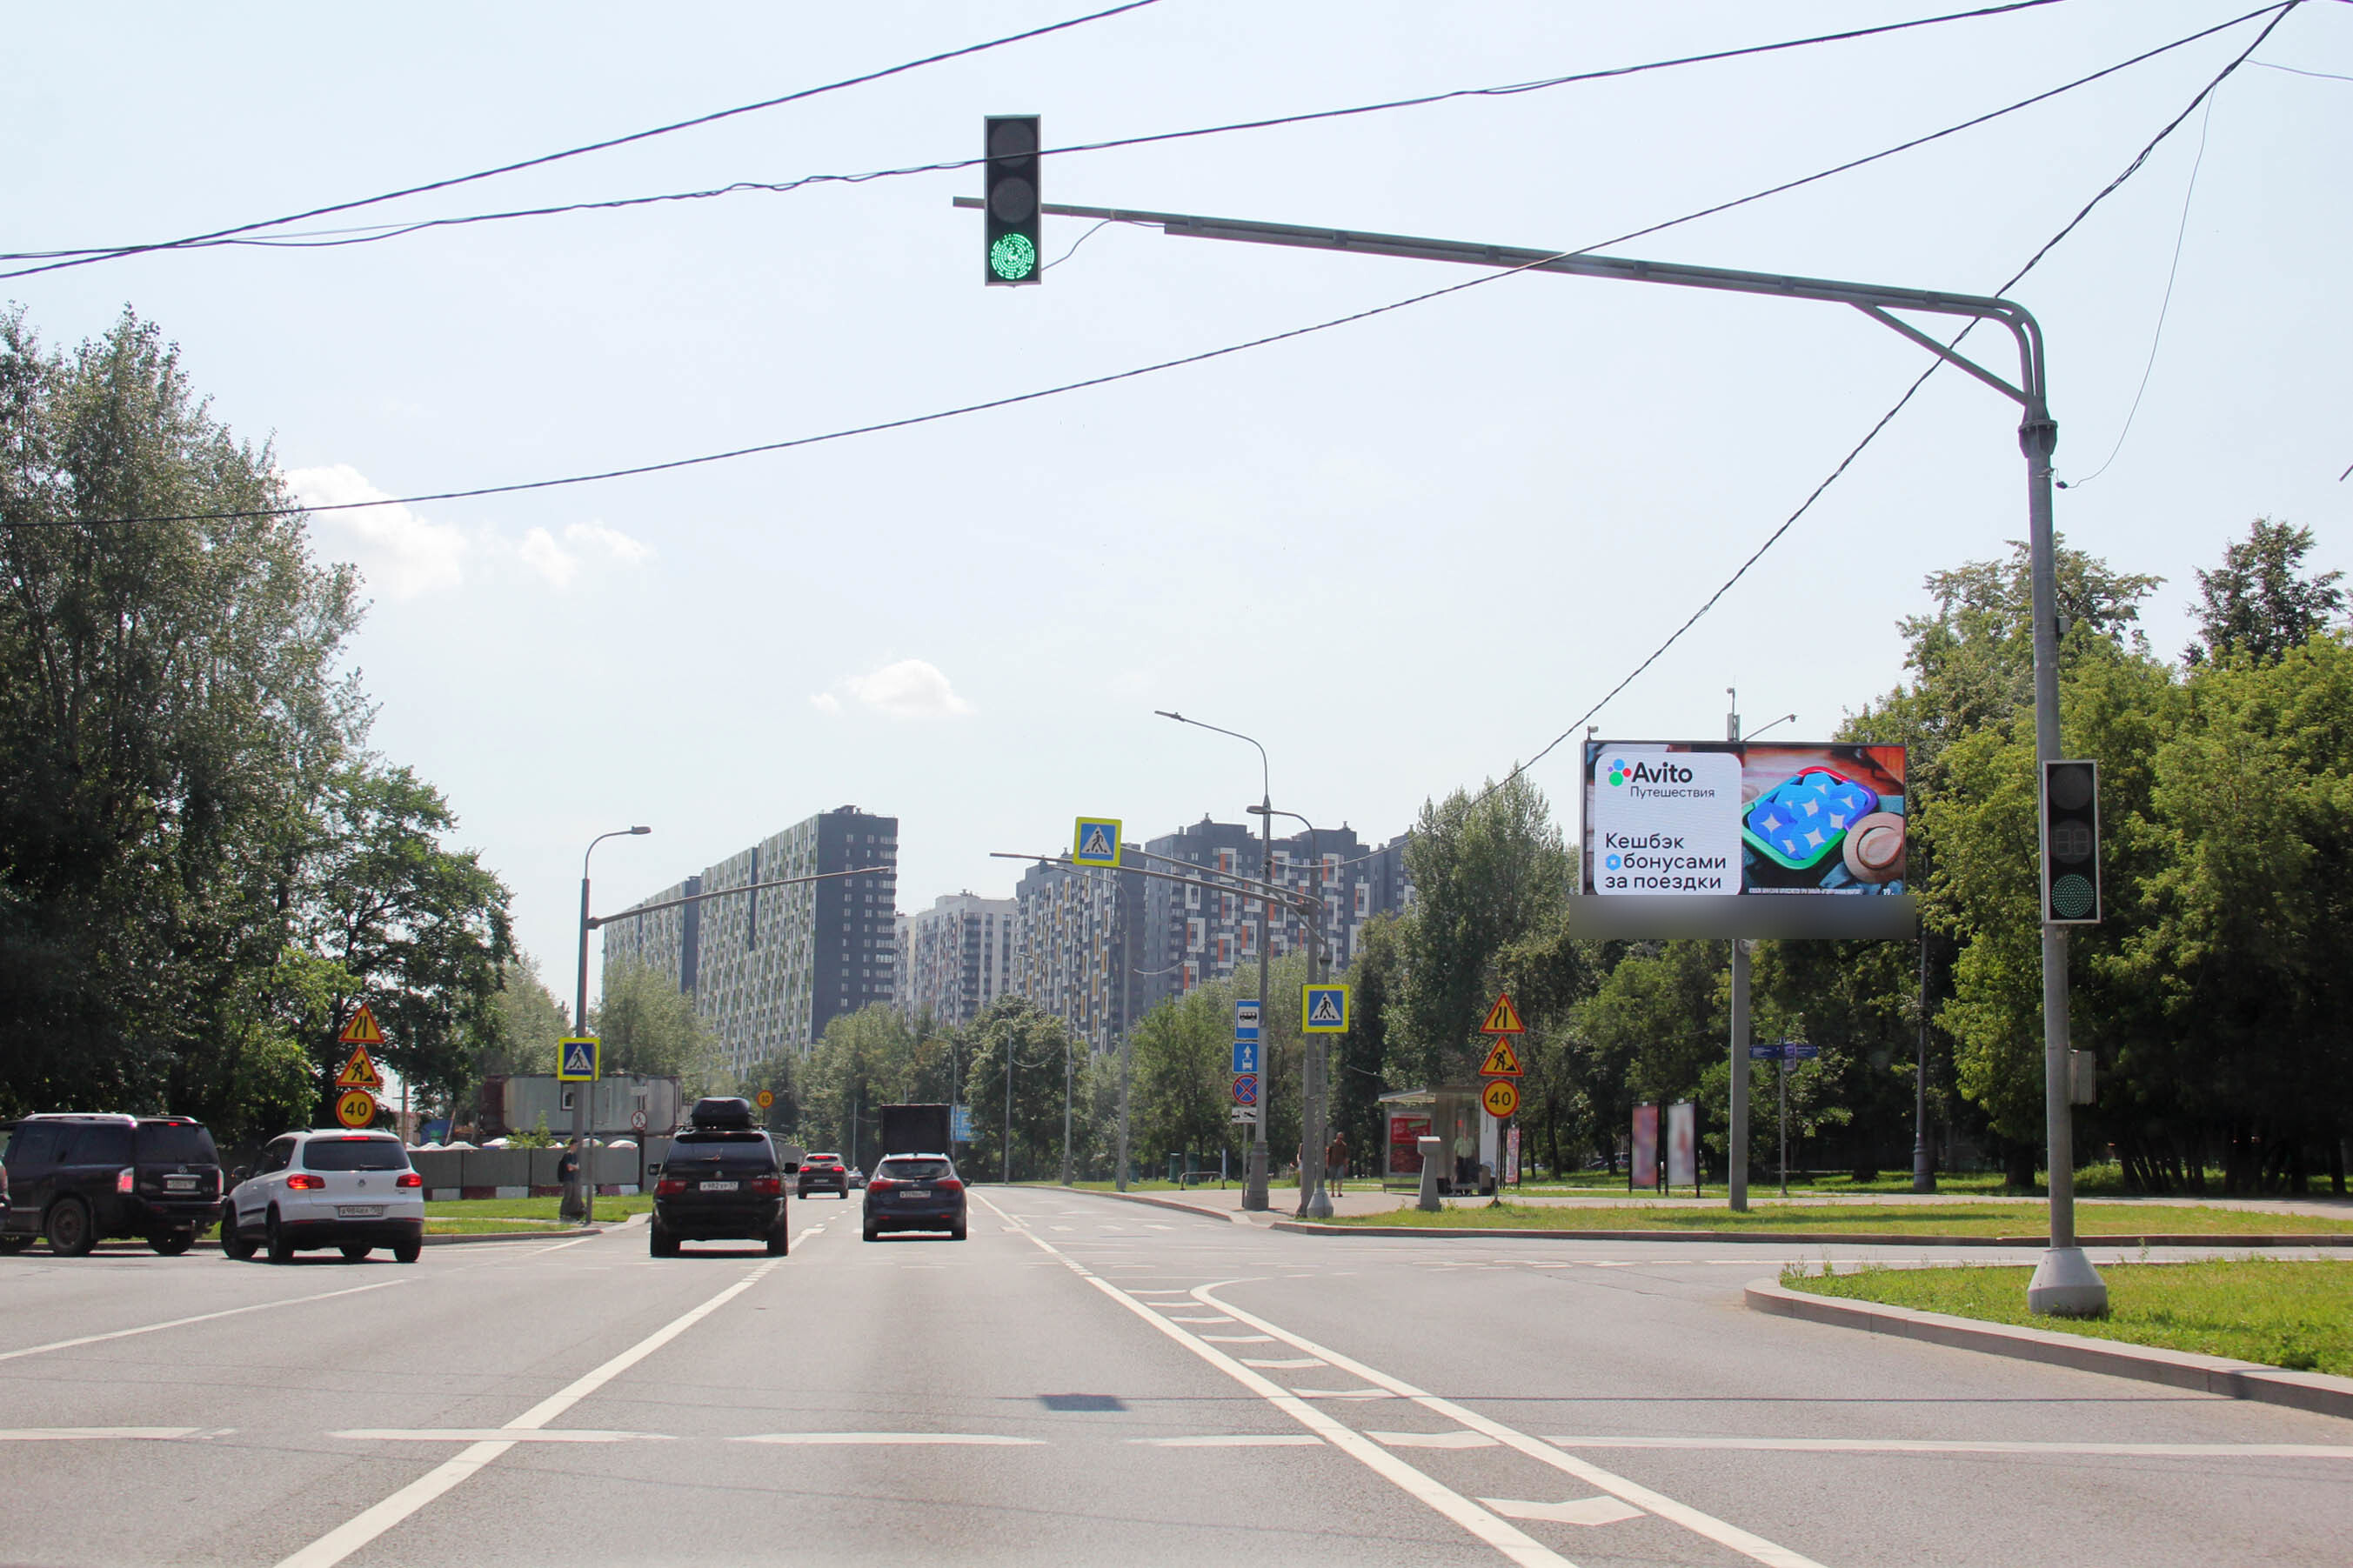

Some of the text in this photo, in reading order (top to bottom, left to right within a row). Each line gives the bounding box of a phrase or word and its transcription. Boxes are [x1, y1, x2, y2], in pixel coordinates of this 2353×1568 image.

[1631, 761, 1693, 784] Avito
[1630, 785, 1715, 799] Путешествия
[1606, 832, 1685, 849] Кешбэк
[1623, 852, 1727, 873] бонусами
[1605, 876, 1721, 891] за поездки
[1488, 1091, 1512, 1106] 40
[344, 1101, 368, 1117] 40
